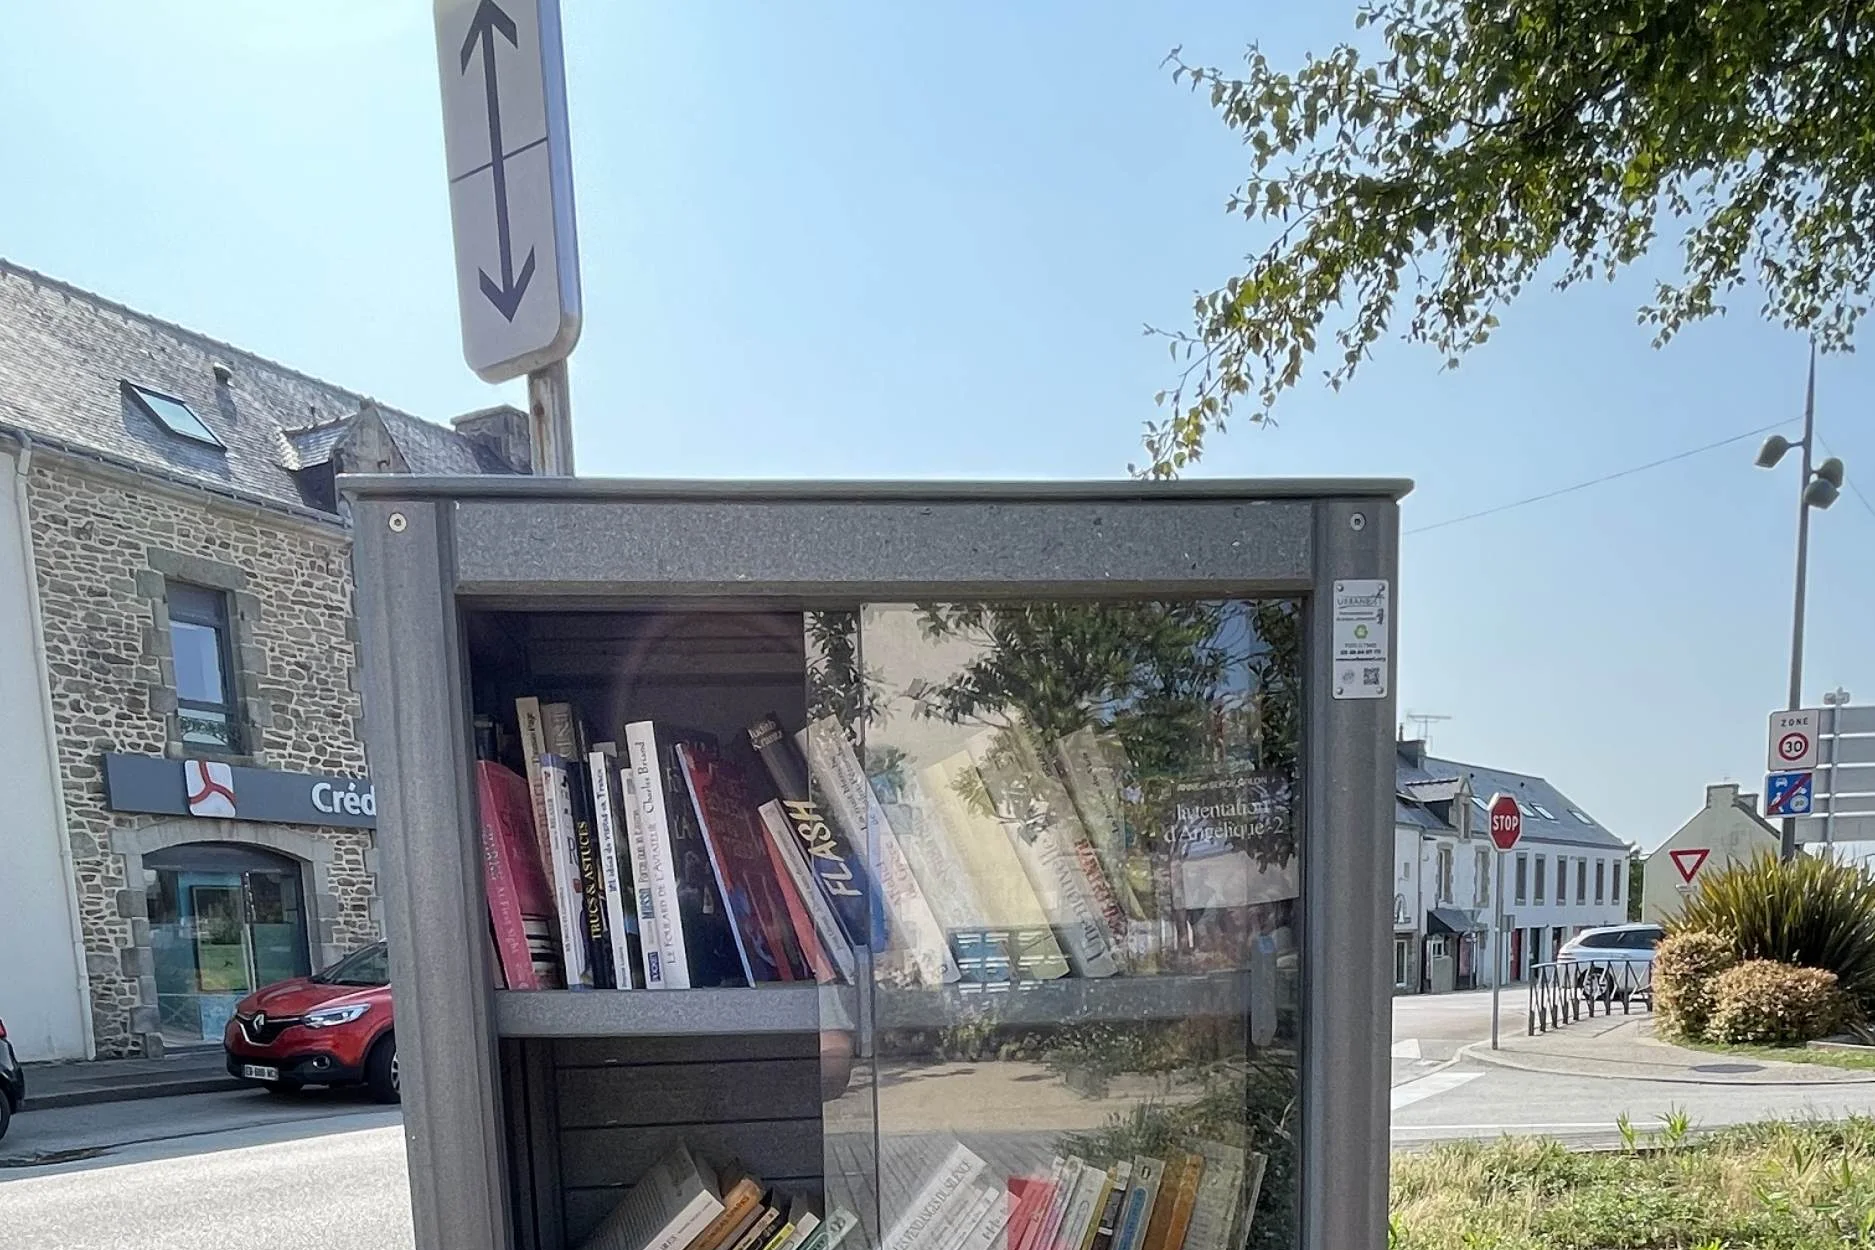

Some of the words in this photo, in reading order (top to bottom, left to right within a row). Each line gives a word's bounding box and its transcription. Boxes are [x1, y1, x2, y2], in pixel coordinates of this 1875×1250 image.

[1781, 717, 1809, 727] ZONE
[1784, 740, 1803, 753] 30
[312, 782, 376, 816] Créd
[1493, 815, 1519, 831] STOP
[576, 820, 594, 879] ASTUCES
[782, 800, 863, 896] FLASH
[584, 882, 596, 894] &
[586, 897, 602, 940] TRUCS
